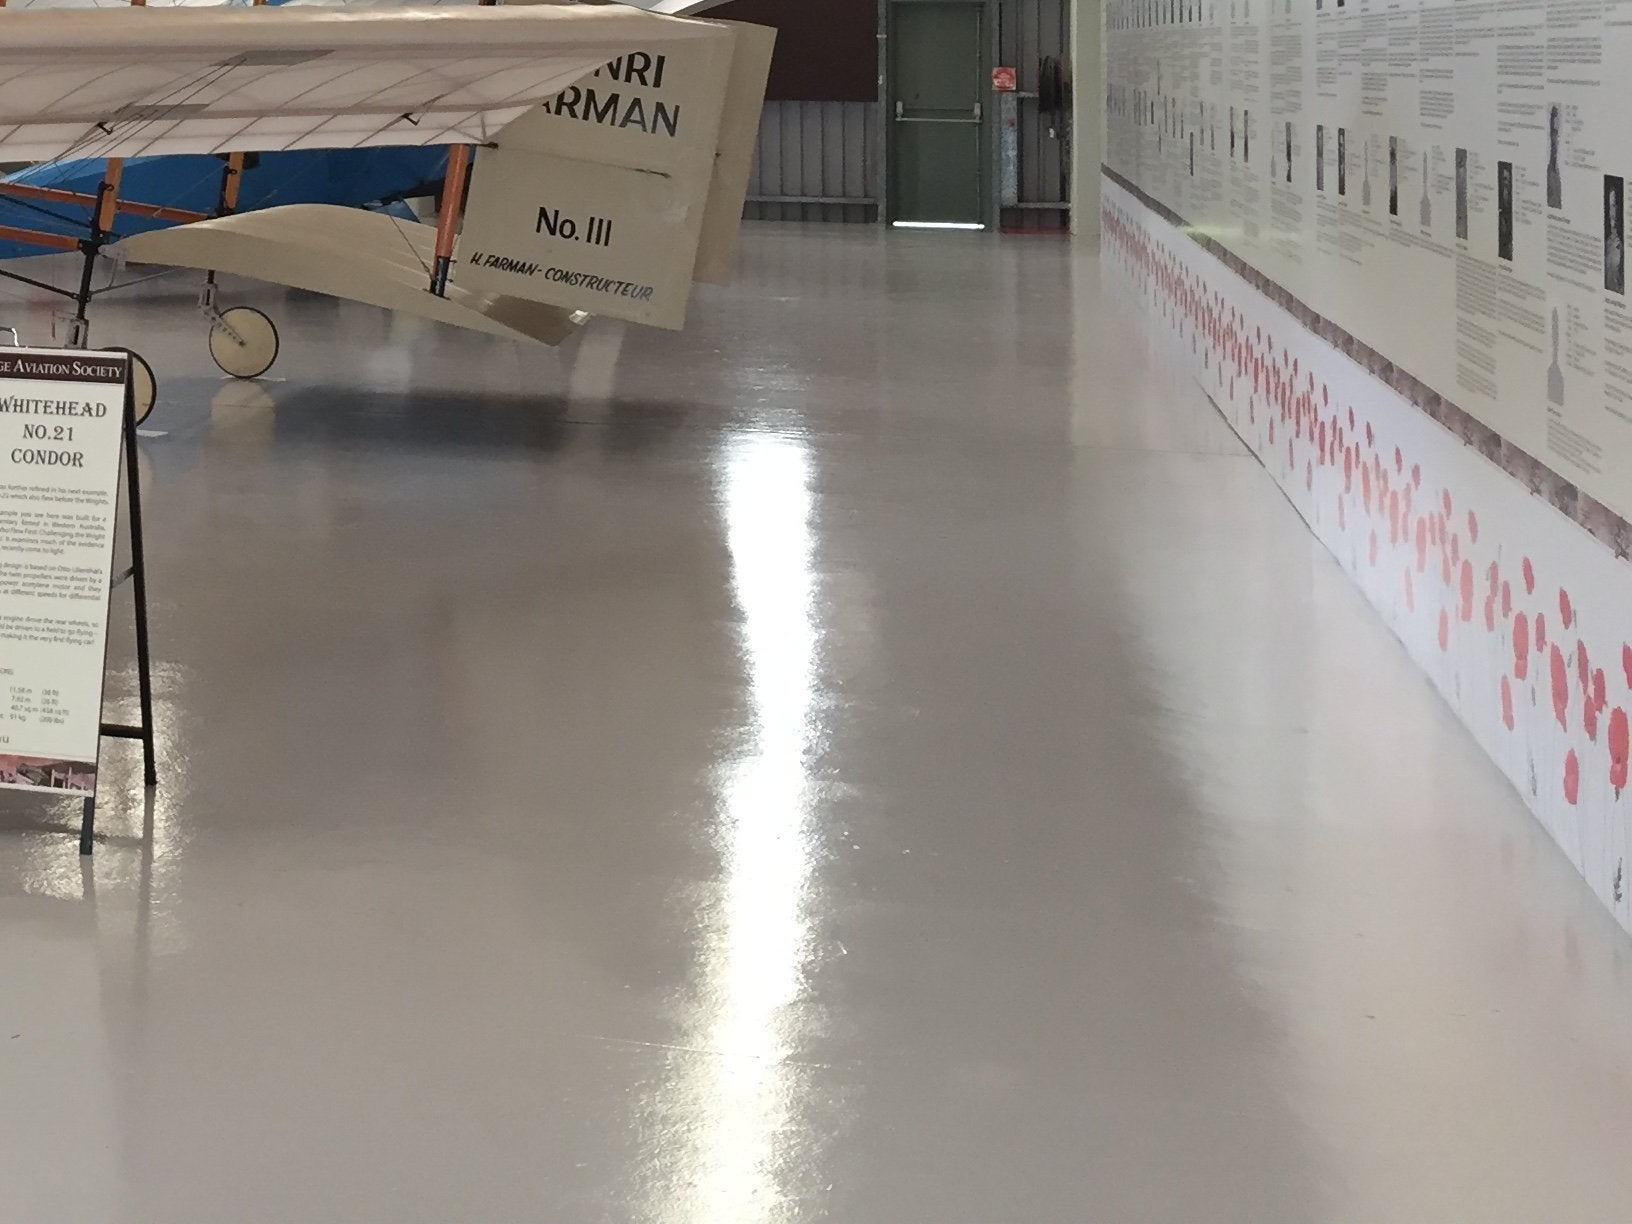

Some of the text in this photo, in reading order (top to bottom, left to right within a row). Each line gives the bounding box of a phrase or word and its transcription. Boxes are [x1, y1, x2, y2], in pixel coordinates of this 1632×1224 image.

[594, 51, 666, 88] NRI
[542, 85, 681, 137] RMAN
[535, 206, 613, 247] No. III
[544, 267, 653, 302] CONSTRUCTEUR
[13, 359, 69, 375] AVIATION
[72, 361, 123, 378] SOCIETY
[22, 424, 74, 442] NO.21
[11, 448, 85, 468] CONDOR
